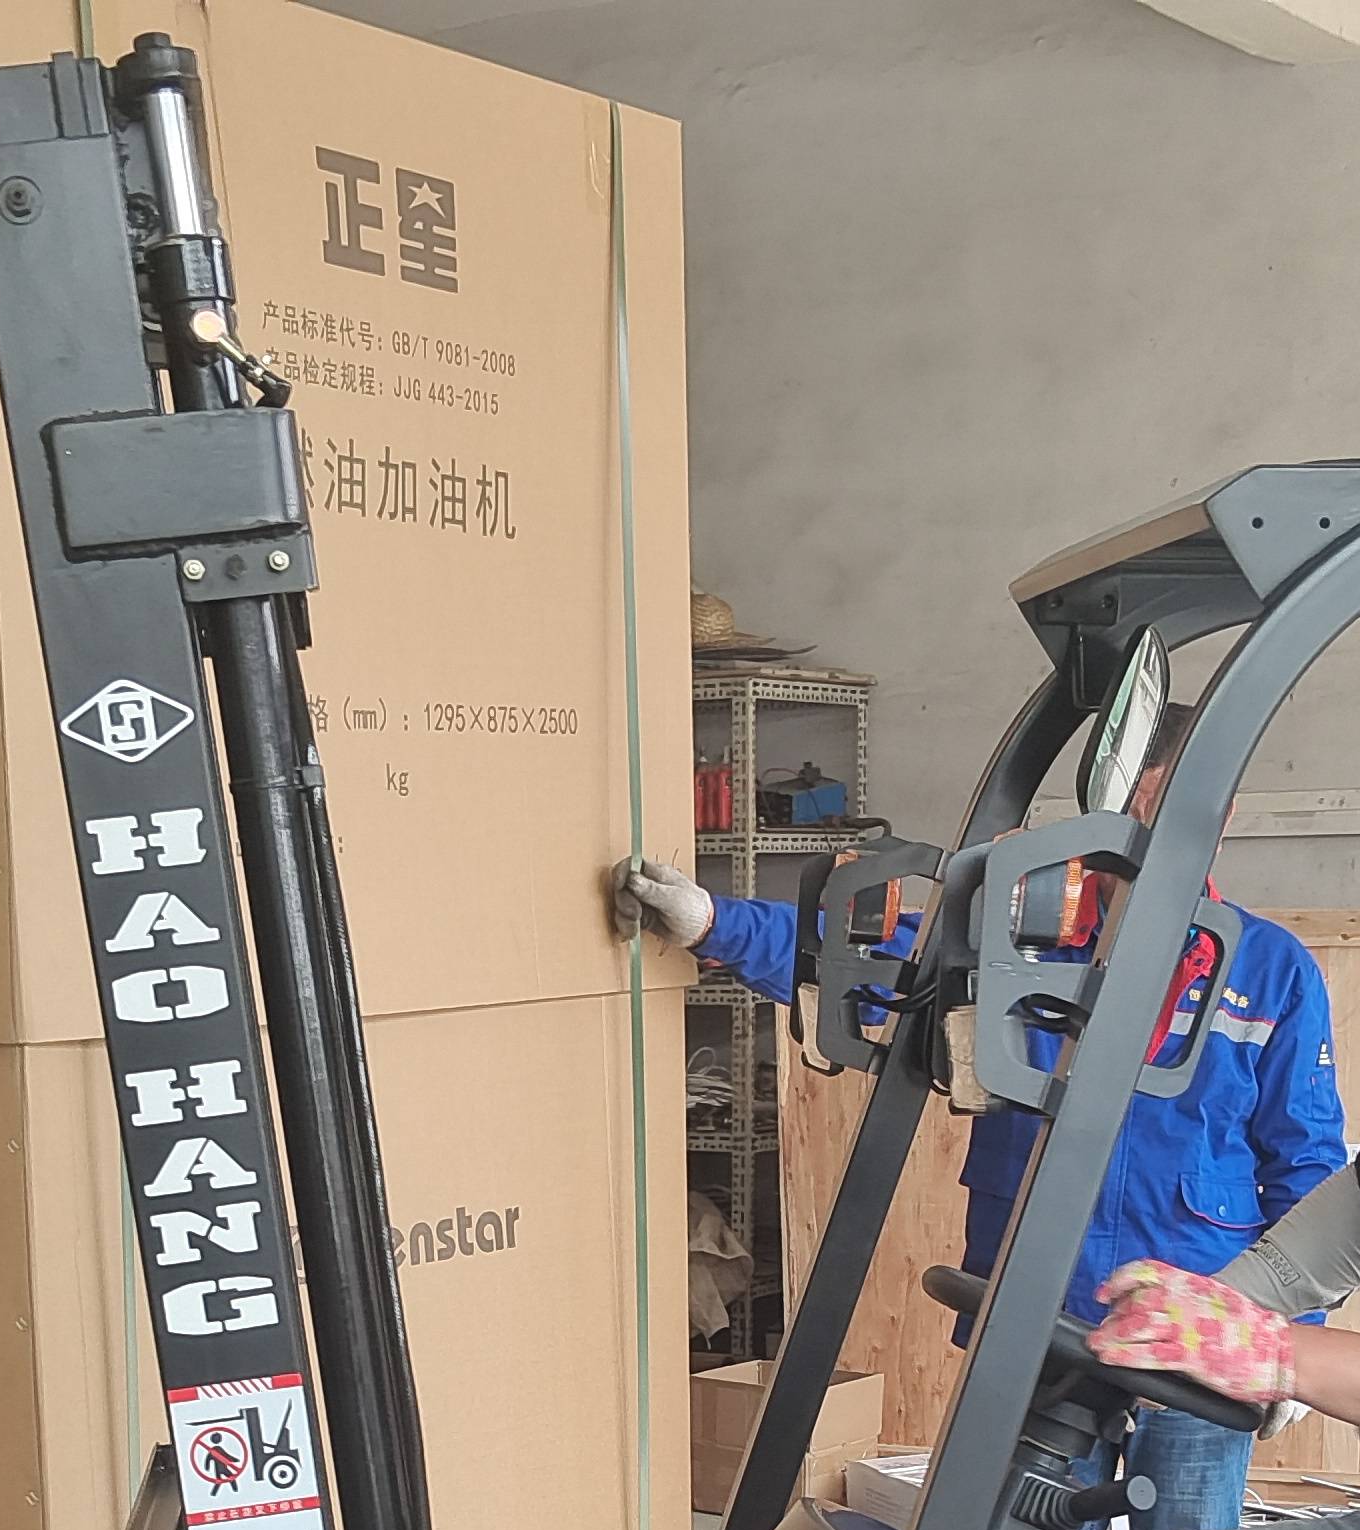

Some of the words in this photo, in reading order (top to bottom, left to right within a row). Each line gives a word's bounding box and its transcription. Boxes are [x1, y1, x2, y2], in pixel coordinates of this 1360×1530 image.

[315, 145, 459, 294] 正星
[428, 381, 499, 416] 443-2015
[436, 339, 516, 377] 9081-2008
[386, 763, 410, 797] kg
[85, 807, 230, 1024] HAO
[125, 1058, 280, 1337] HANG
